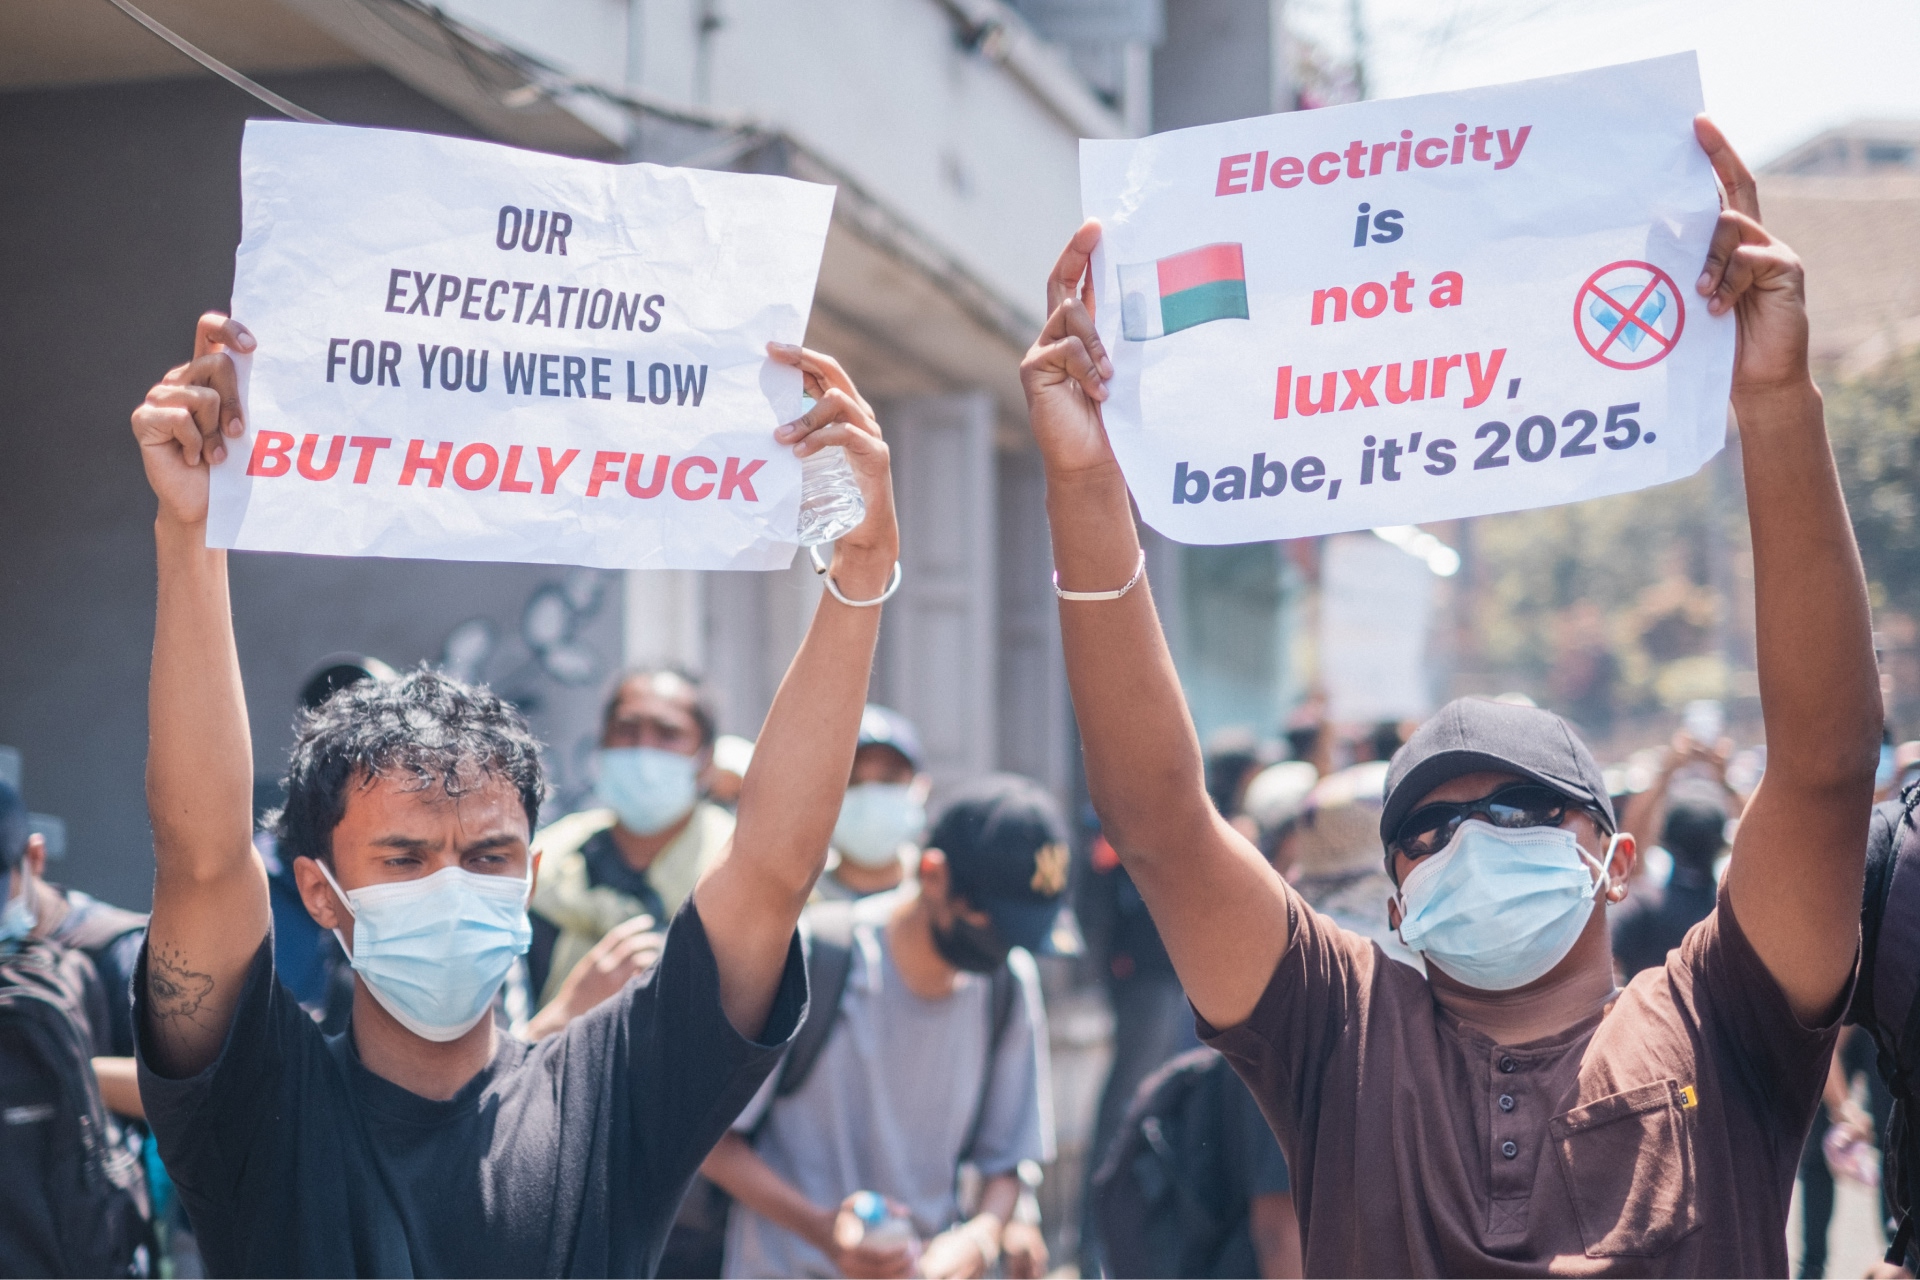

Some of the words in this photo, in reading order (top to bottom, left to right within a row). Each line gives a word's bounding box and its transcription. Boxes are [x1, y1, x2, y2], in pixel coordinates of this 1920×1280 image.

[1216, 123, 1531, 196] Electricity
[496, 205, 573, 256] OUR
[1354, 203, 1404, 247] is
[385, 269, 665, 333] EXPECTATIONS
[1311, 271, 1415, 325] not
[1429, 271, 1463, 308] a
[326, 338, 402, 387] FOR
[418, 344, 489, 393] YOU
[503, 351, 612, 400] WERE
[626, 360, 708, 407] LOW
[1274, 348, 1521, 420] luxury,
[246, 430, 392, 484] BUT
[398, 439, 580, 494] HOLY
[586, 451, 767, 501] FUCK
[1173, 453, 1341, 504] babe,
[1360, 432, 1456, 485] it's
[1474, 403, 1656, 470] 2025.
